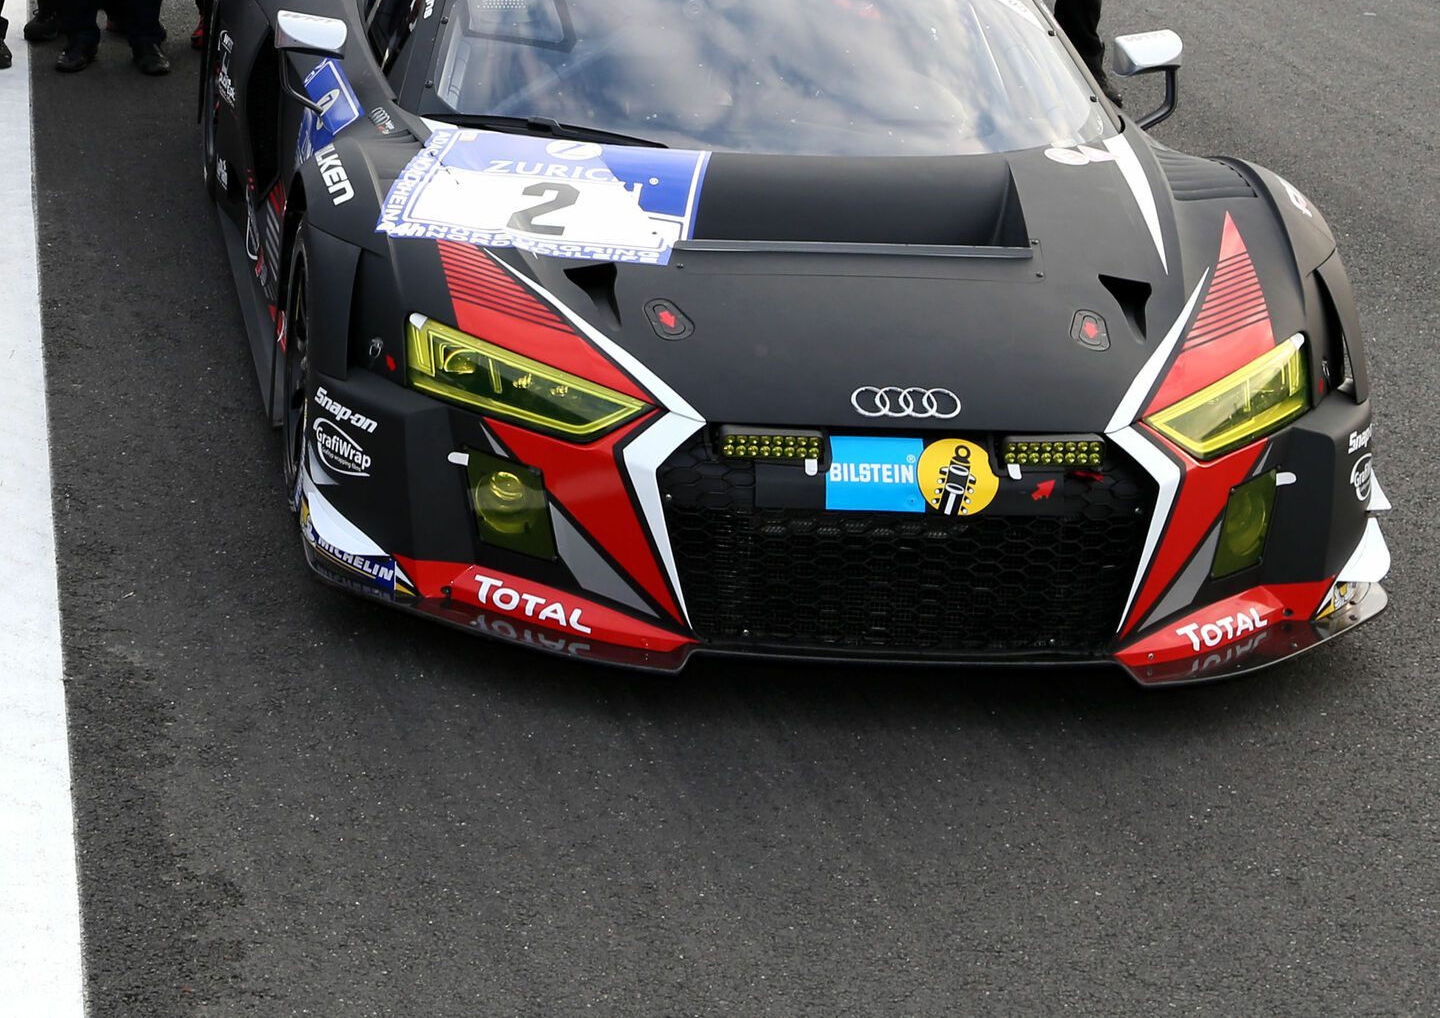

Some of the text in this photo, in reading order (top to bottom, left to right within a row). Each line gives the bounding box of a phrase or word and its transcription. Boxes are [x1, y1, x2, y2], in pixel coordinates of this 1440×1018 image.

[486, 159, 617, 182] ZURIC
[506, 181, 580, 237] 2
[314, 386, 378, 434] Snap-on
[316, 426, 372, 471] GrafiWrap
[474, 574, 592, 634] TOTAL
[1176, 607, 1268, 652] TOTAL
